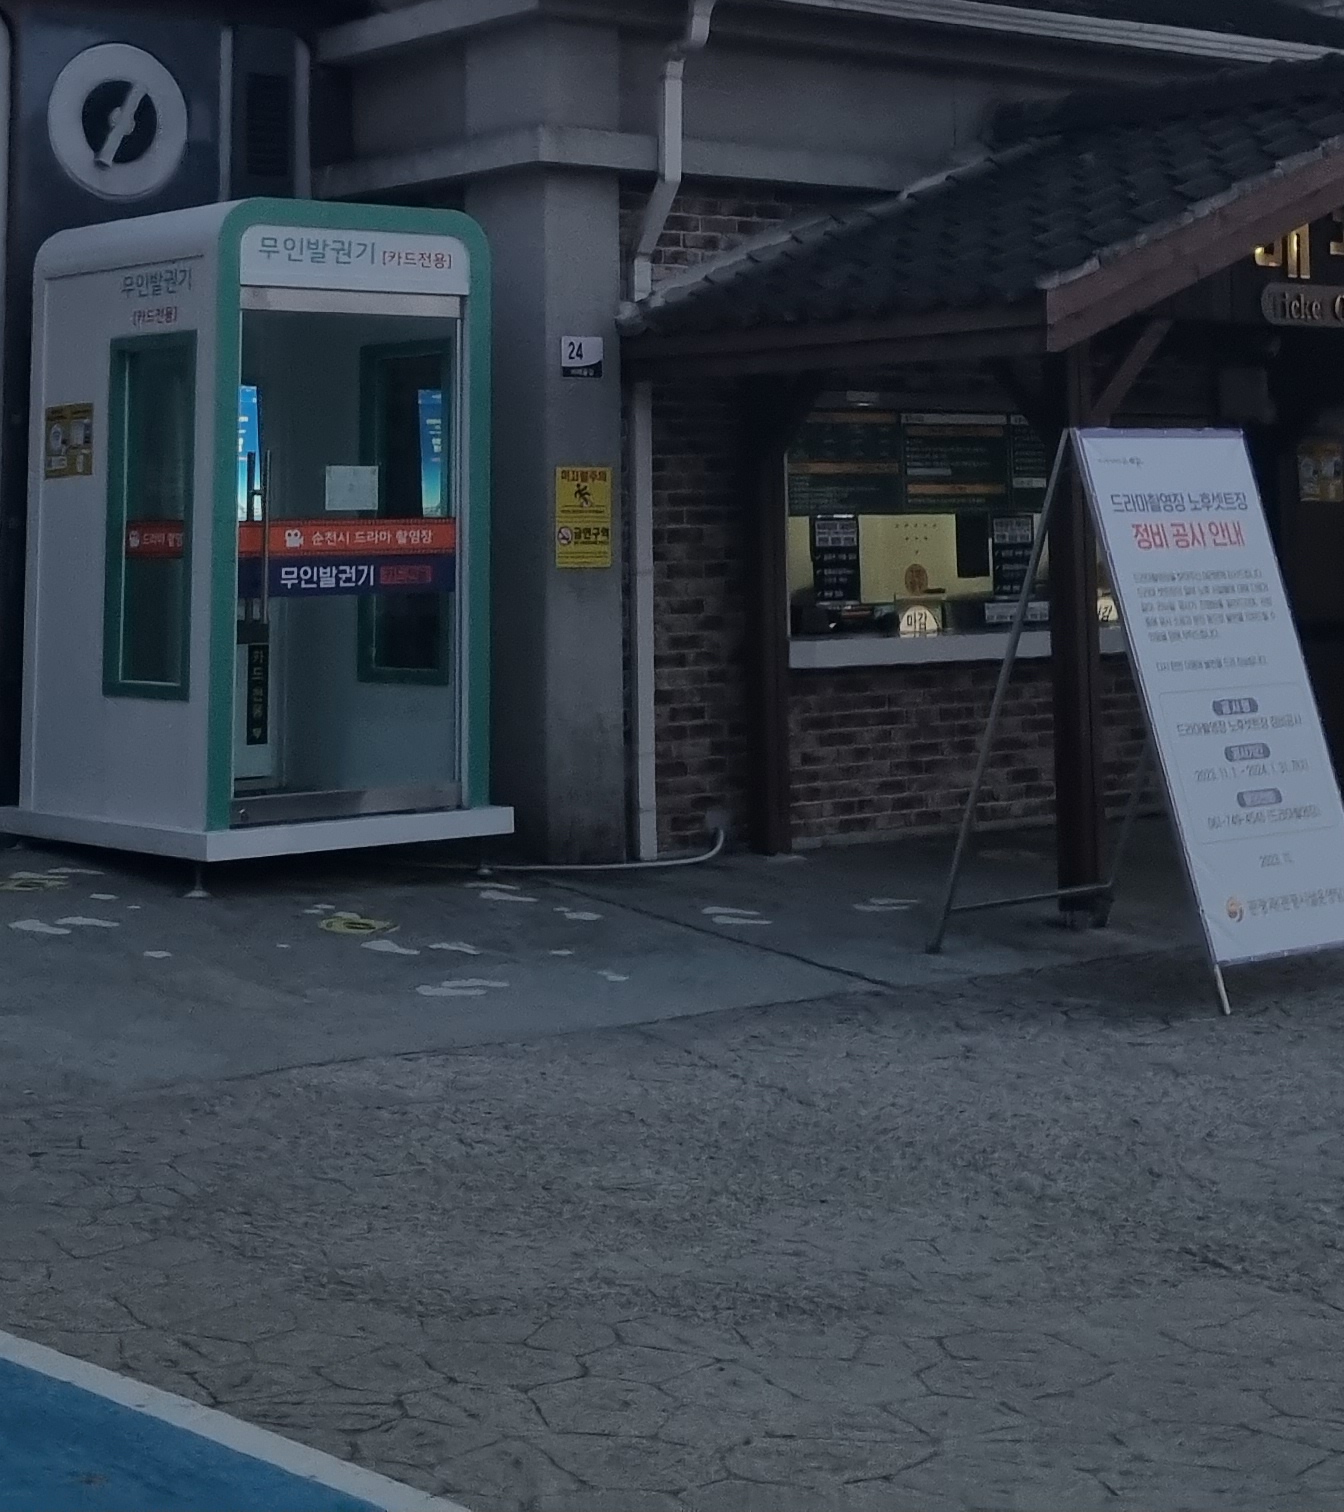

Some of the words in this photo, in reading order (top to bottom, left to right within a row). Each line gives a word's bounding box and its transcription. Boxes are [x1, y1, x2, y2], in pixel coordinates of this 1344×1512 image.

[258, 235, 377, 266] 무인발권기
[381, 249, 453, 270] [카드전용]
[119, 268, 193, 299] 무인발권기
[568, 340, 583, 360] 24
[311, 529, 350, 546] 순천시
[353, 530, 393, 545] 드라마
[395, 528, 434, 545] 촬영장
[1131, 521, 1170, 551] 정비
[1169, 521, 1207, 549] 공사
[1208, 519, 1246, 548] 안내
[280, 564, 375, 590] 무인발권기
